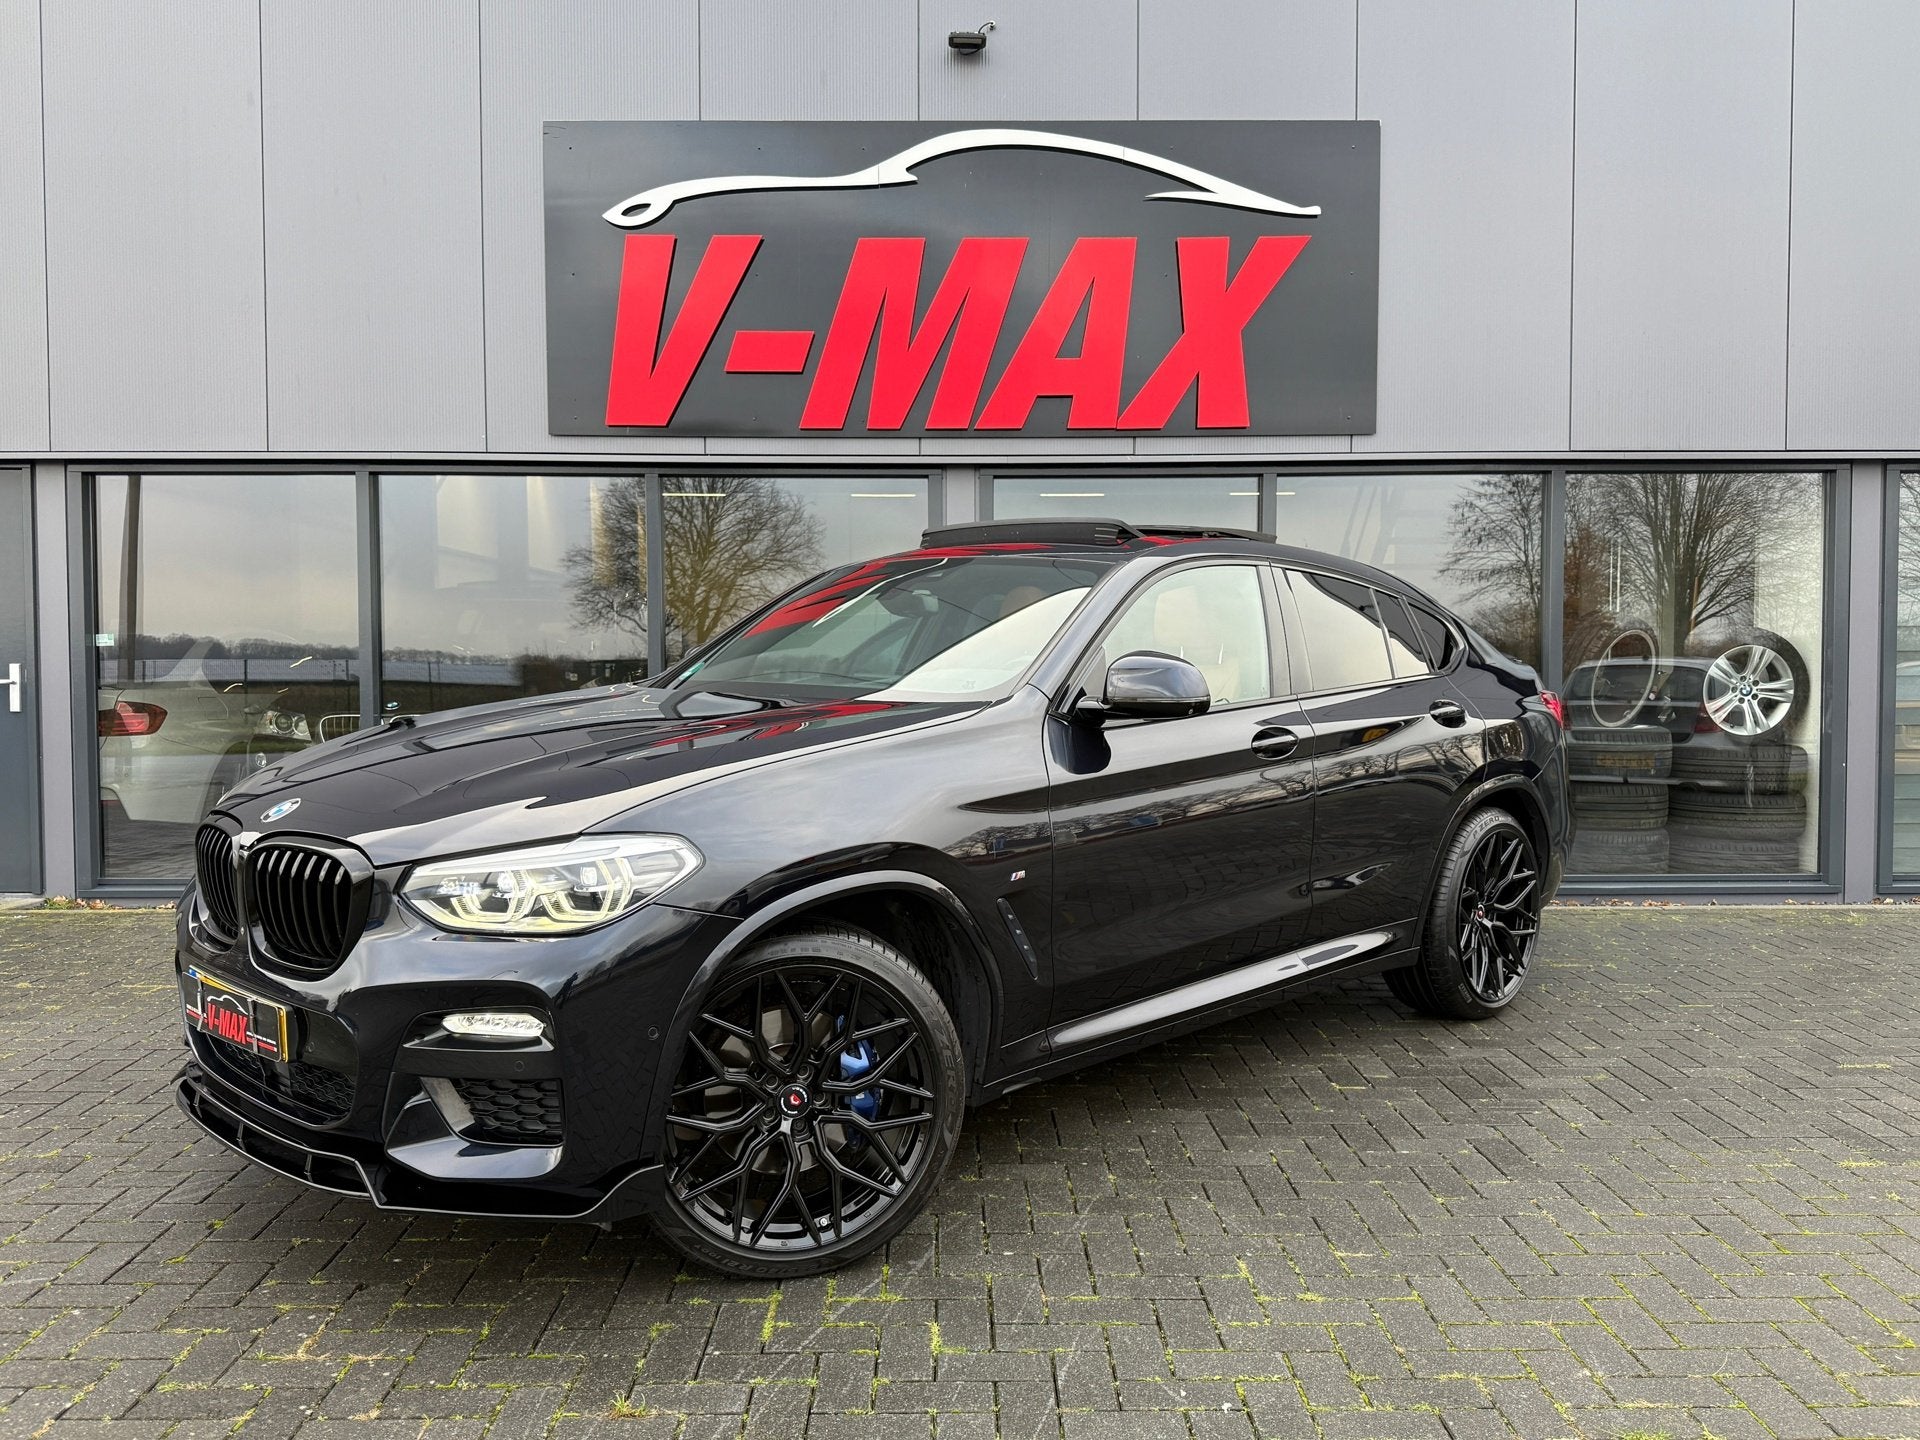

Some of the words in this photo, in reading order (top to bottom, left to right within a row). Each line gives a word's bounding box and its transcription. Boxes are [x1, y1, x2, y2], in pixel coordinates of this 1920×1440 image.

[606, 235, 1311, 430] V-MAX
[1479, 816, 1499, 831] ZERO
[208, 1003, 248, 1045] V-MAX
